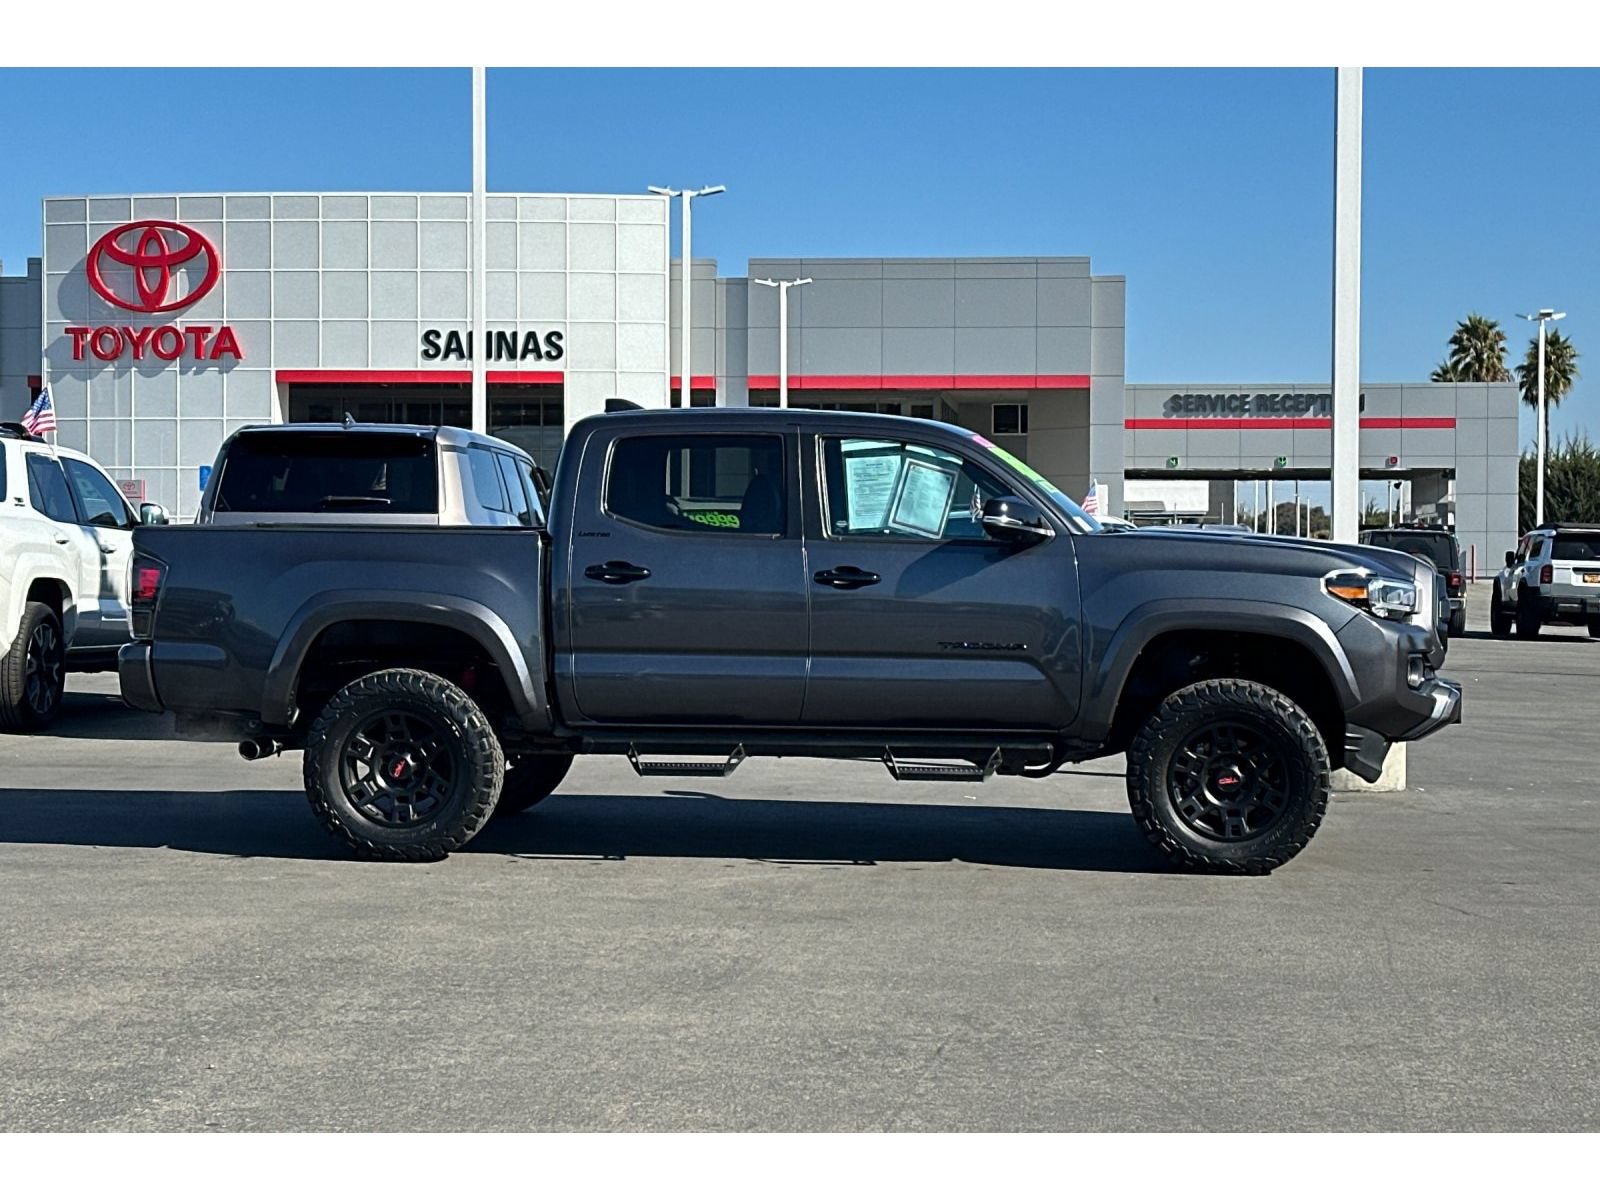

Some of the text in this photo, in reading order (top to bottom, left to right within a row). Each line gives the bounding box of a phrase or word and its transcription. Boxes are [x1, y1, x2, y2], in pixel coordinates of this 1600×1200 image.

[64, 326, 243, 361] TOYOTA
[422, 329, 564, 361] SAINAS
[1170, 393, 1365, 413] SERVICE RECEPT
